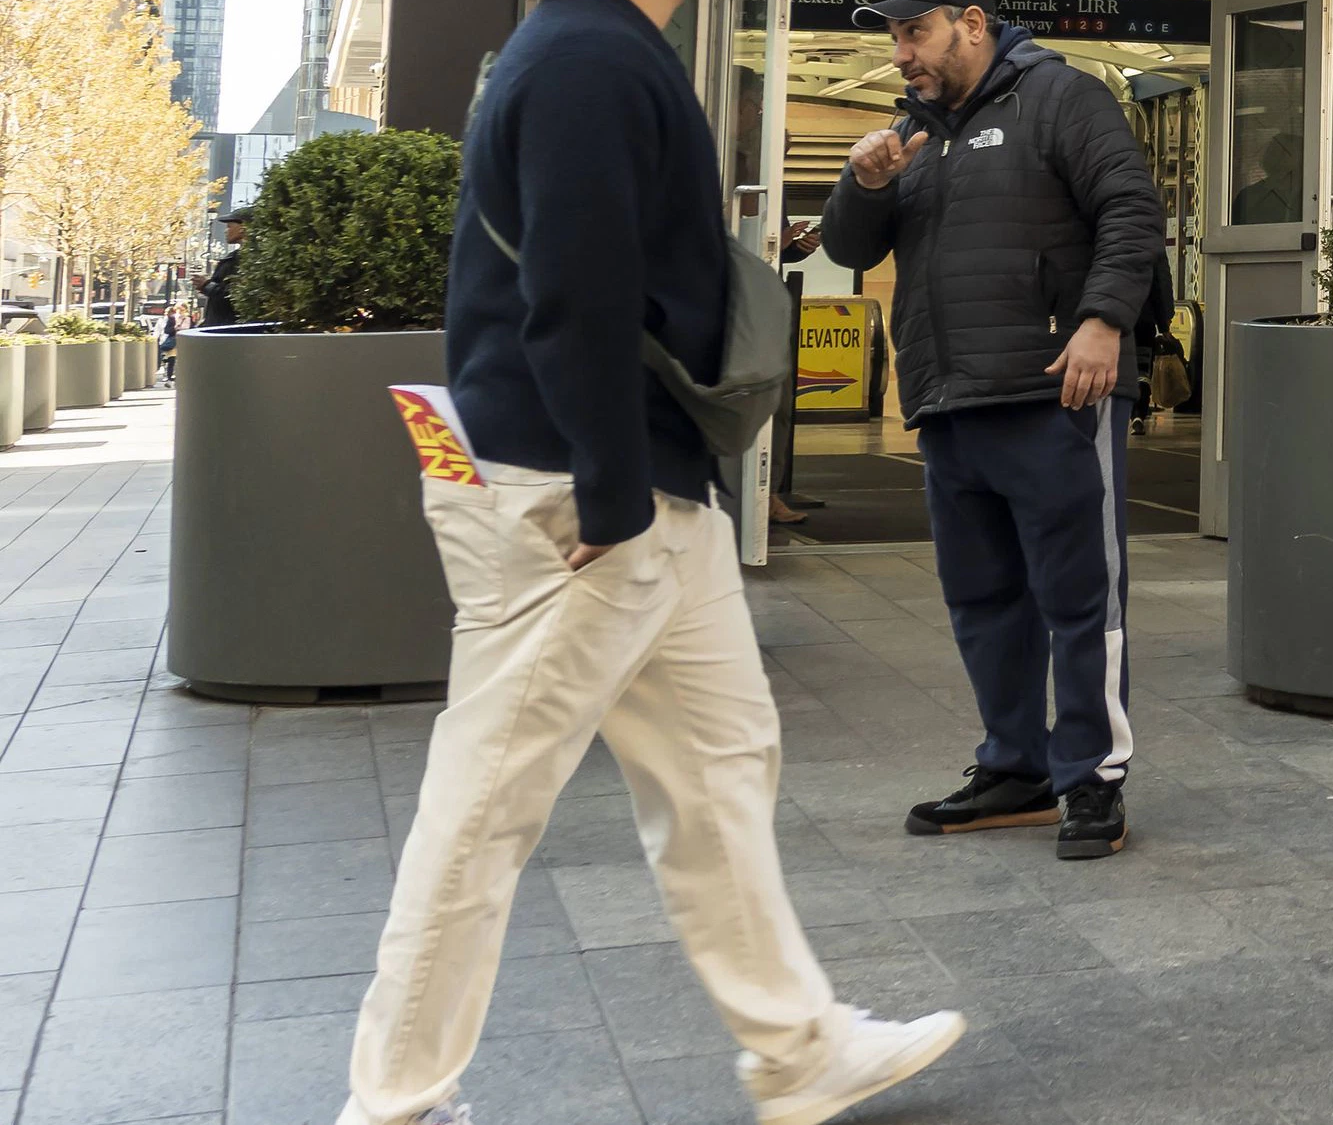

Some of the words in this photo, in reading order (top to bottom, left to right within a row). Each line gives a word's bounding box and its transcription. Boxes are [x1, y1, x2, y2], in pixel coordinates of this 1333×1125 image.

[1080, 21, 1087, 30] 2
[1096, 21, 1104, 30] 3
[1128, 23, 1137, 32] A
[1145, 23, 1153, 33] C
[1161, 24, 1169, 33] E
